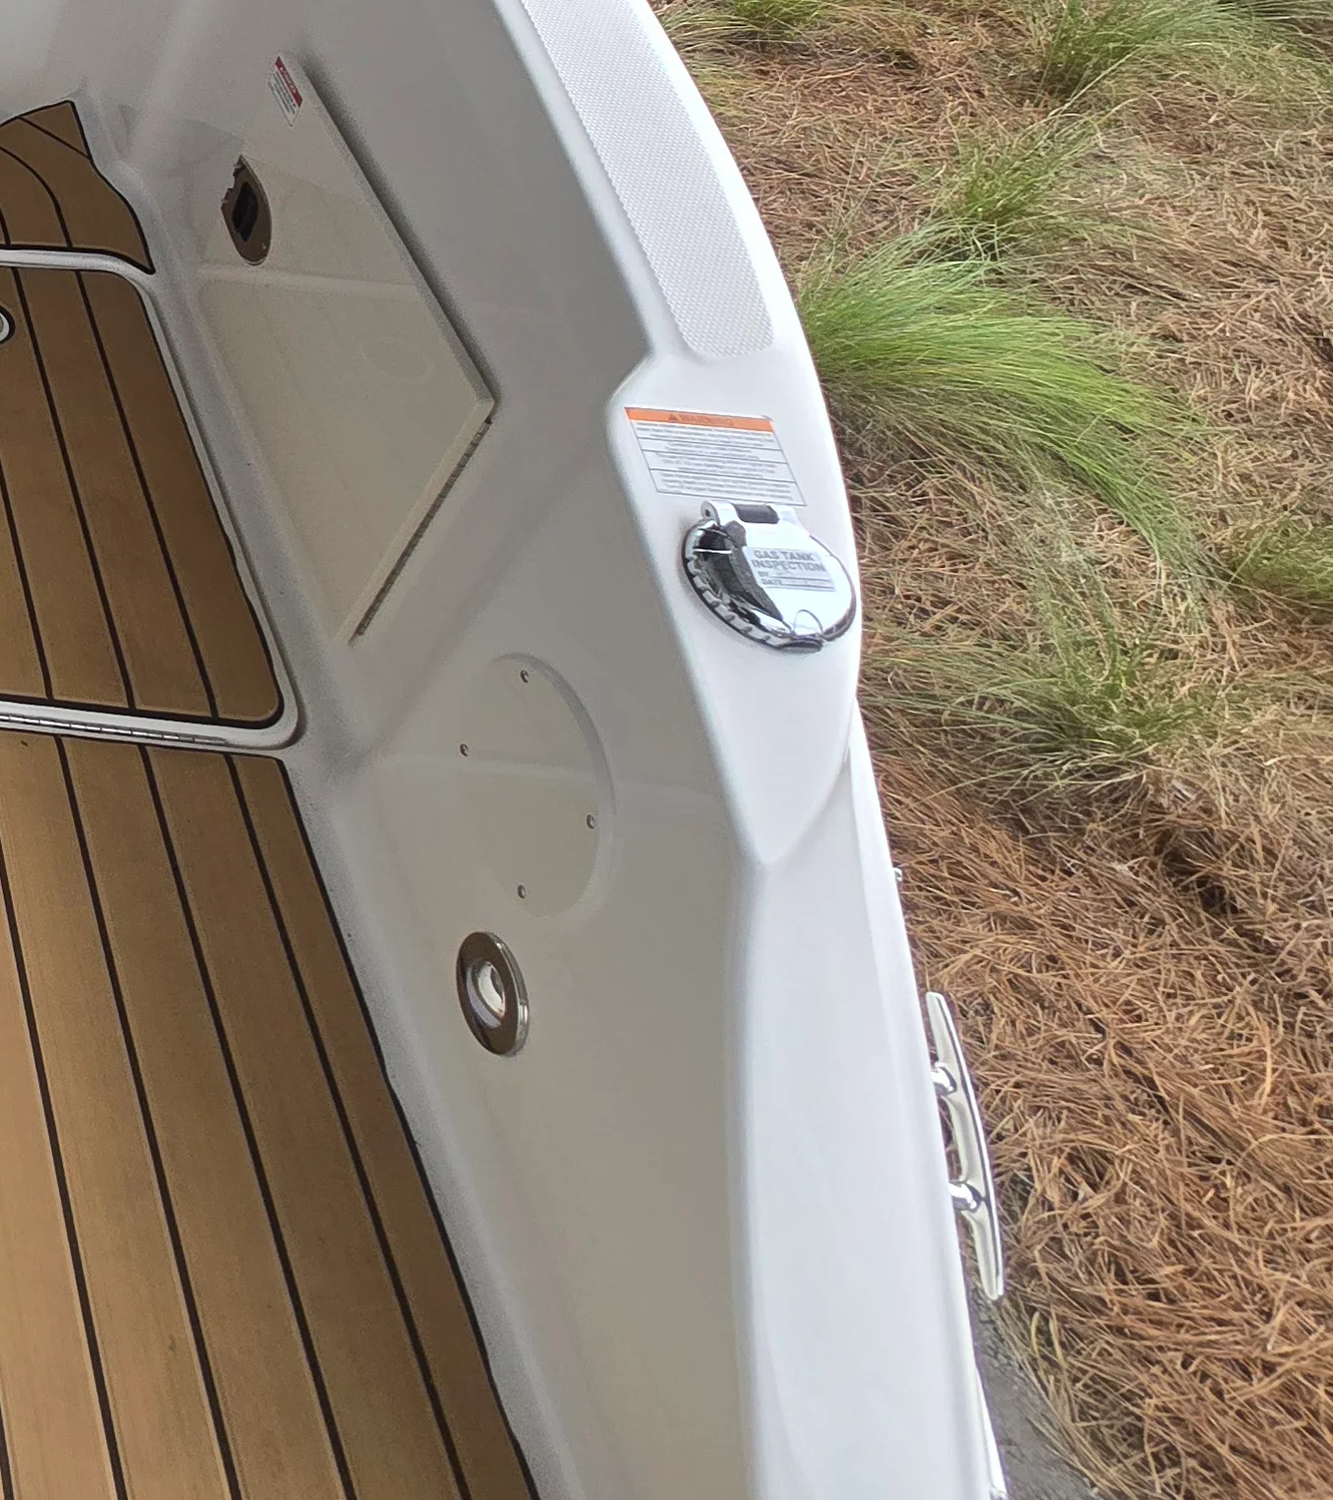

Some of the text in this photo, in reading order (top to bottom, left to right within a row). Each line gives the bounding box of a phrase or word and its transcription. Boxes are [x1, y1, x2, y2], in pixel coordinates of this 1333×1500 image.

[753, 549, 815, 562] GAS TANK
[751, 559, 827, 572] INSPECTION
